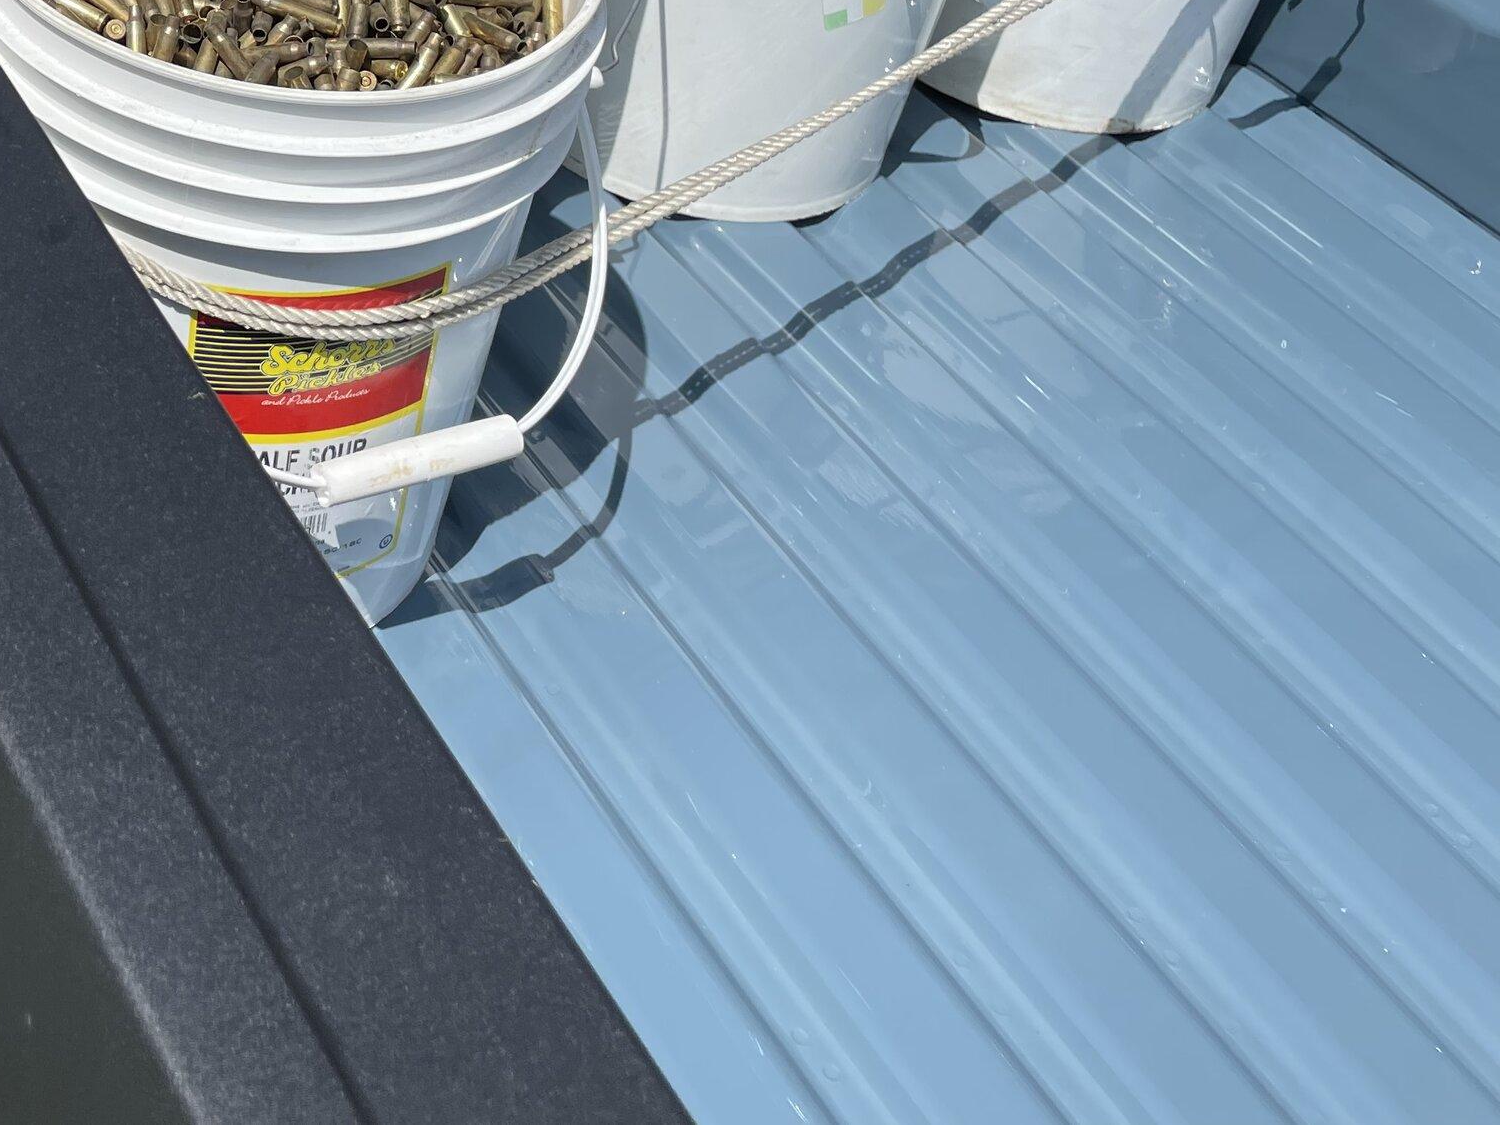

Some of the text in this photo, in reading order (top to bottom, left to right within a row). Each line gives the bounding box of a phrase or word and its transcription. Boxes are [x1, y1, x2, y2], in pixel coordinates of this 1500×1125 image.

[267, 362, 382, 396] Pickles
[261, 388, 370, 406] and Pickle Products
[257, 450, 300, 471] ALF
